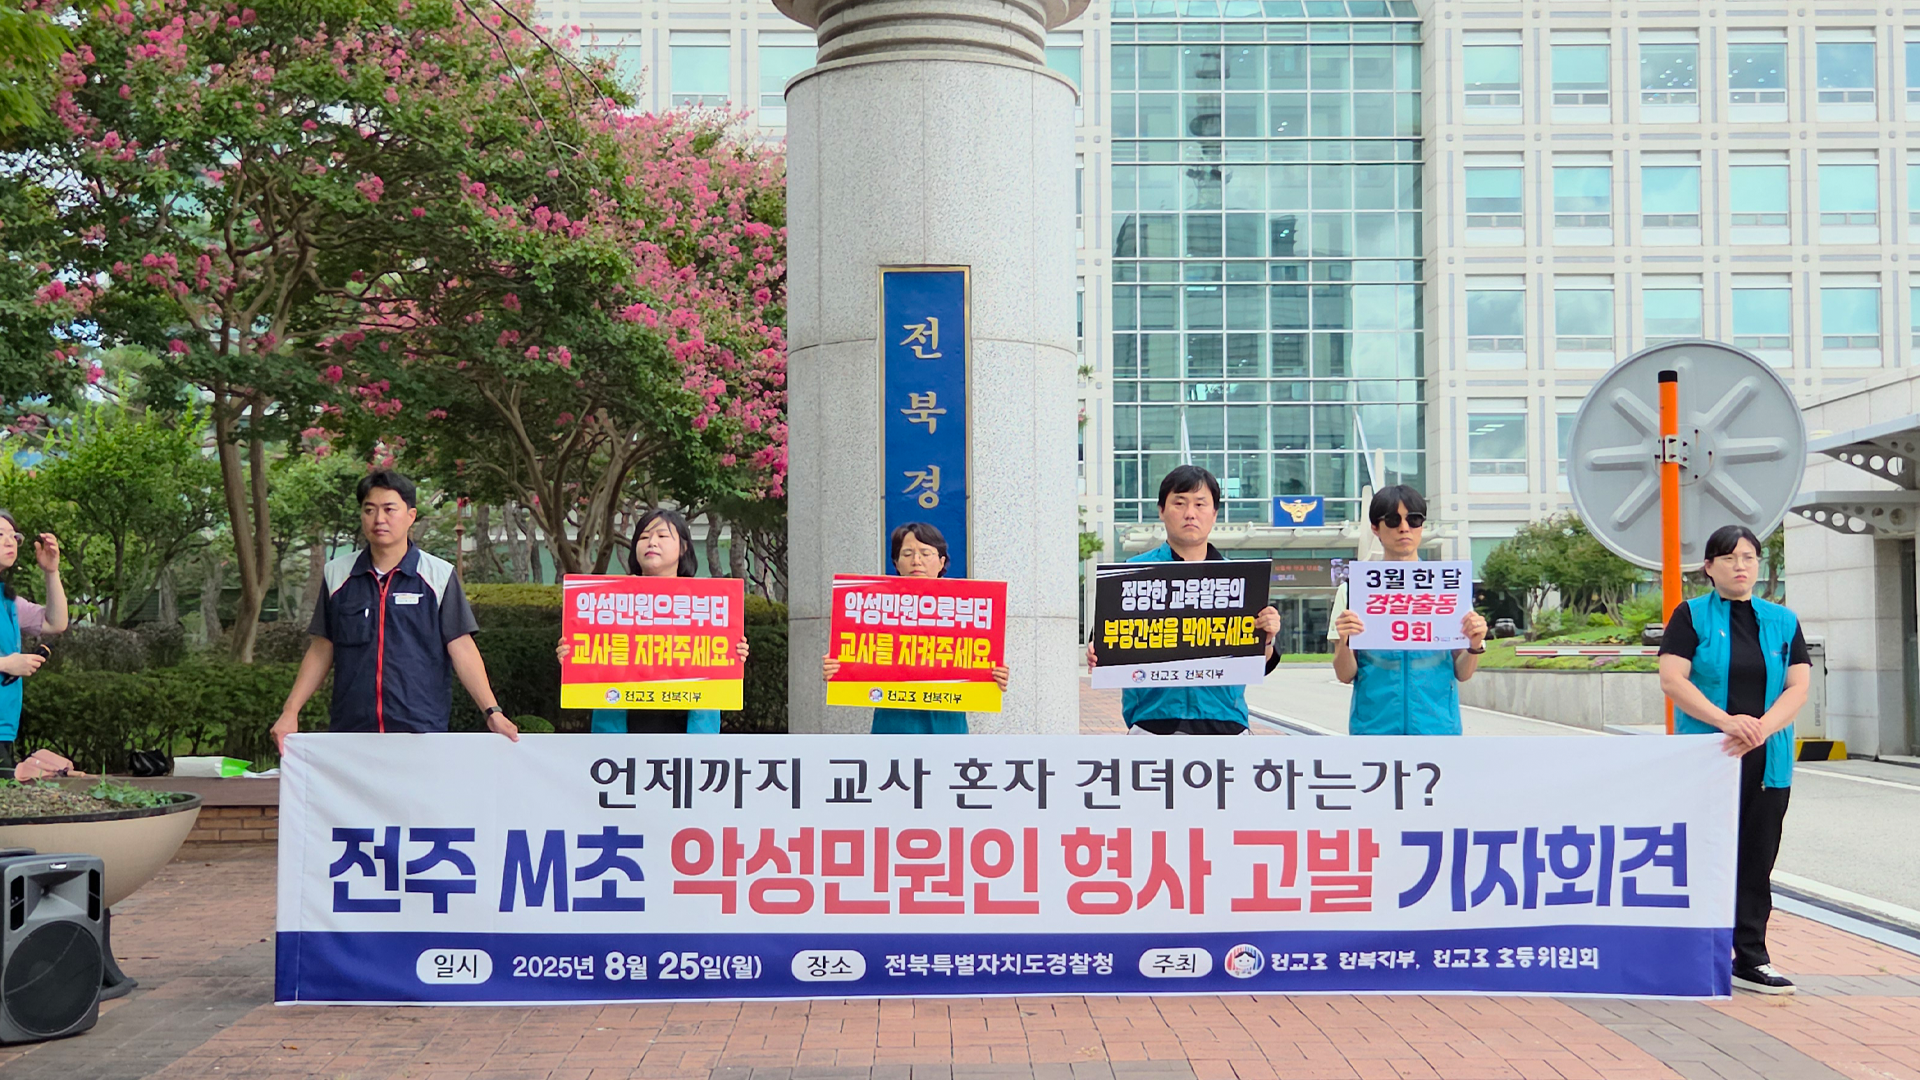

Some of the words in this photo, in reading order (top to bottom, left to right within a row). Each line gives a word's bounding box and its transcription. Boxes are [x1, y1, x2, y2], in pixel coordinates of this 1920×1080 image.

[1121, 579, 1167, 611] 정당한
[1169, 577, 1245, 610] 교육활동의
[1366, 568, 1405, 590] 3월
[1412, 568, 1435, 590] 한
[1442, 568, 1462, 590] 달
[576, 592, 729, 627] 악성민원으로부터
[844, 592, 992, 630] 악성민원으로부터
[1366, 593, 1458, 615] 경찰출동
[1103, 617, 1179, 649] 부당간섭을
[1182, 616, 1260, 648] 막아주세요.
[1391, 620, 1432, 642] 9회
[571, 633, 630, 666] 교사를
[634, 634, 735, 667] 지켜주세요.
[837, 632, 894, 665] 교사를
[898, 634, 996, 669] 지켜주세요.
[590, 758, 801, 809] 언제까지
[825, 758, 931, 809] 교사
[949, 758, 1055, 809] 혼자
[1075, 758, 1234, 810] 견뎌야
[1253, 758, 1441, 810] 하는가?
[329, 827, 476, 913] 전주
[499, 826, 645, 912] M초
[671, 827, 1040, 914] 악성민원인
[1061, 827, 1212, 915] 형사
[1231, 827, 1380, 913] 고발
[1398, 822, 1690, 912] 기자회견
[434, 954, 478, 979] 일시
[513, 955, 594, 980] 2025년
[604, 951, 648, 981] 8월
[658, 951, 762, 980] 25일(월)
[807, 955, 853, 977] 장소
[884, 953, 1115, 976] 전북특별자치도경찰청
[1152, 953, 1196, 974] 주최
